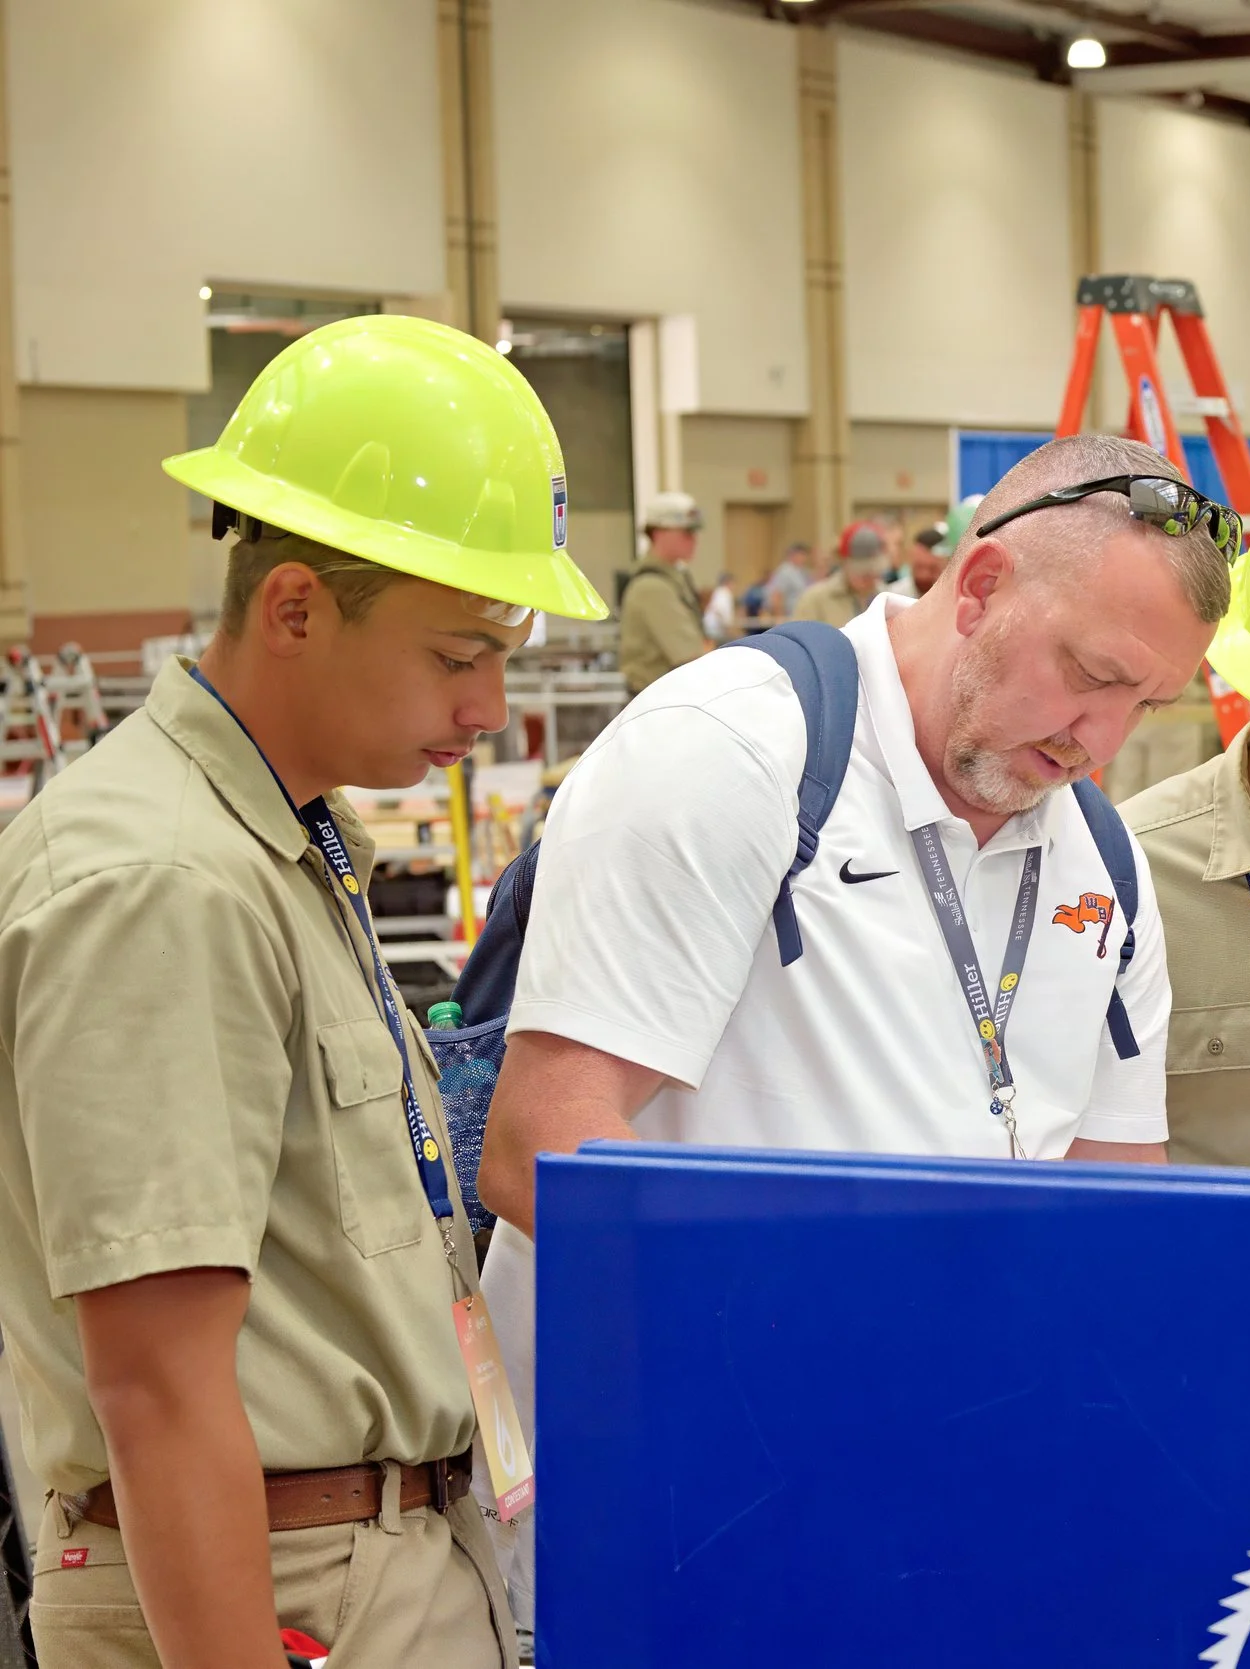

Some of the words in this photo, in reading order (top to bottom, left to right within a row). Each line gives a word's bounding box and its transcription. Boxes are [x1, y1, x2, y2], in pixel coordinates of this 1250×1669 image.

[316, 820, 352, 875] Hiller
[921, 826, 947, 890] TENNESSEE
[1015, 886, 1031, 941] TENNESSEE
[963, 964, 990, 1020] Hiller
[994, 989, 1013, 1036] Hille
